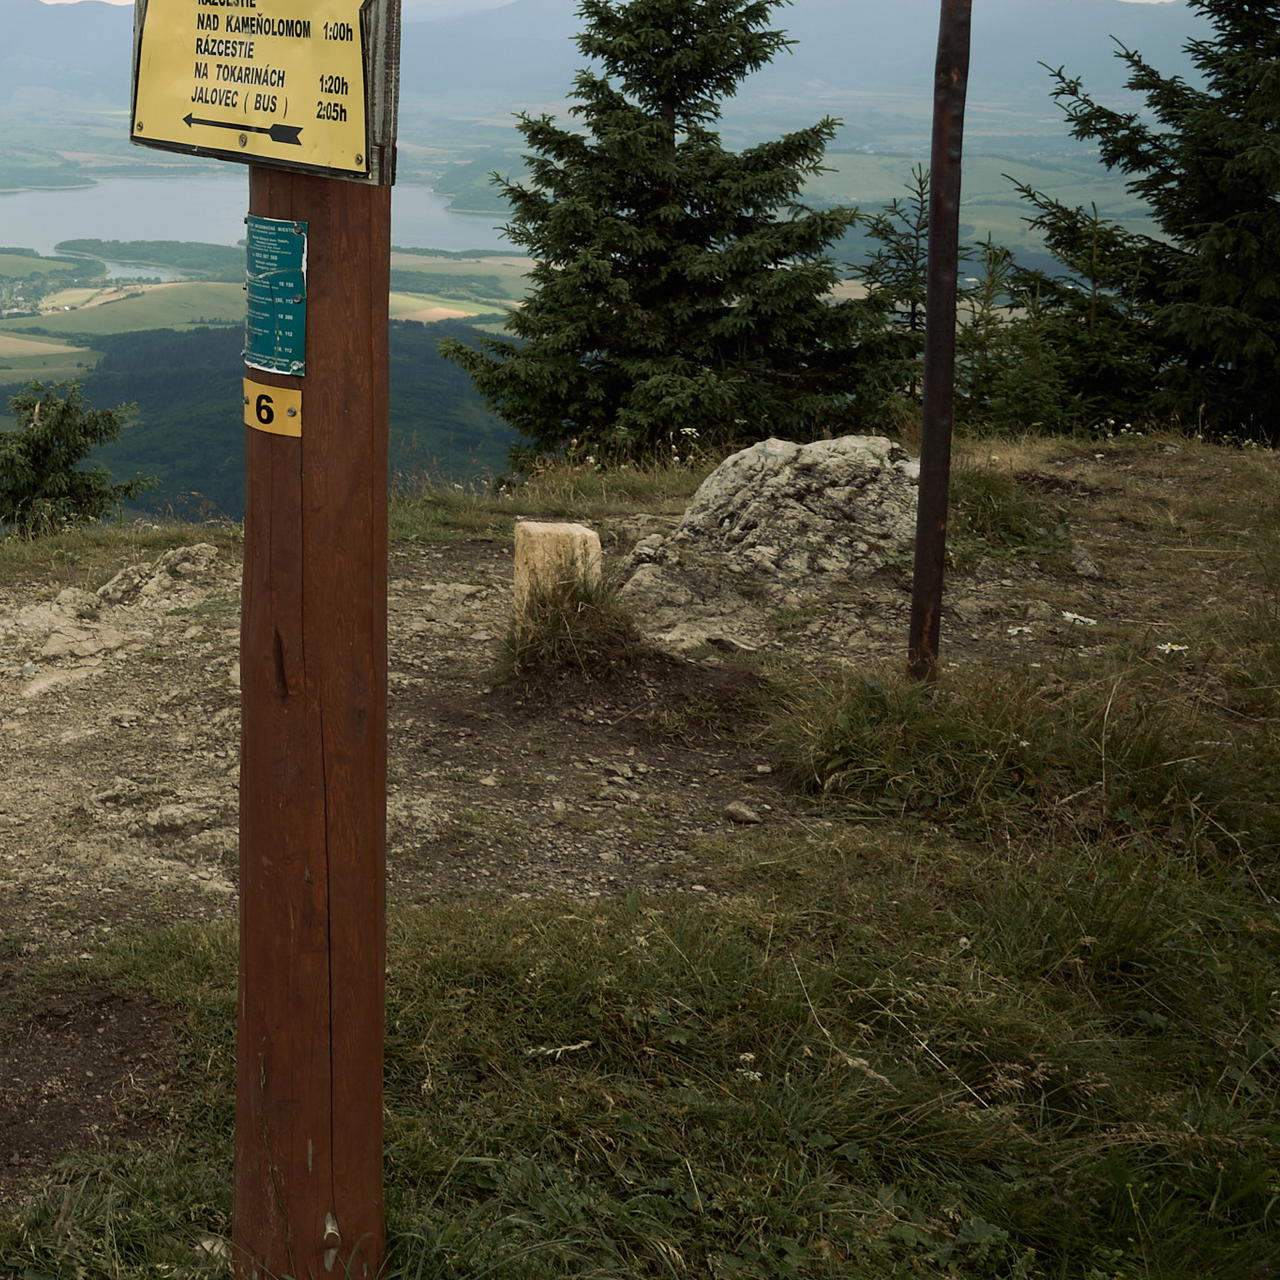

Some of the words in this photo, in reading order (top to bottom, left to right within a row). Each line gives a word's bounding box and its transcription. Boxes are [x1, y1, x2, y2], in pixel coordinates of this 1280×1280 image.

[197, 13, 219, 31] NAD
[226, 13, 311, 39] KAMEŇOLOMOM
[324, 22, 353, 41] 1:00h
[196, 36, 254, 59] RÁZCESTIE
[194, 62, 208, 79] NA
[216, 64, 285, 88] TOKARINÁCH
[320, 74, 348, 95] 1:20h
[191, 86, 238, 108] JALOVEC
[254, 94, 277, 113] BUS
[316, 101, 347, 122] 2:05h
[255, 394, 274, 424] 6
